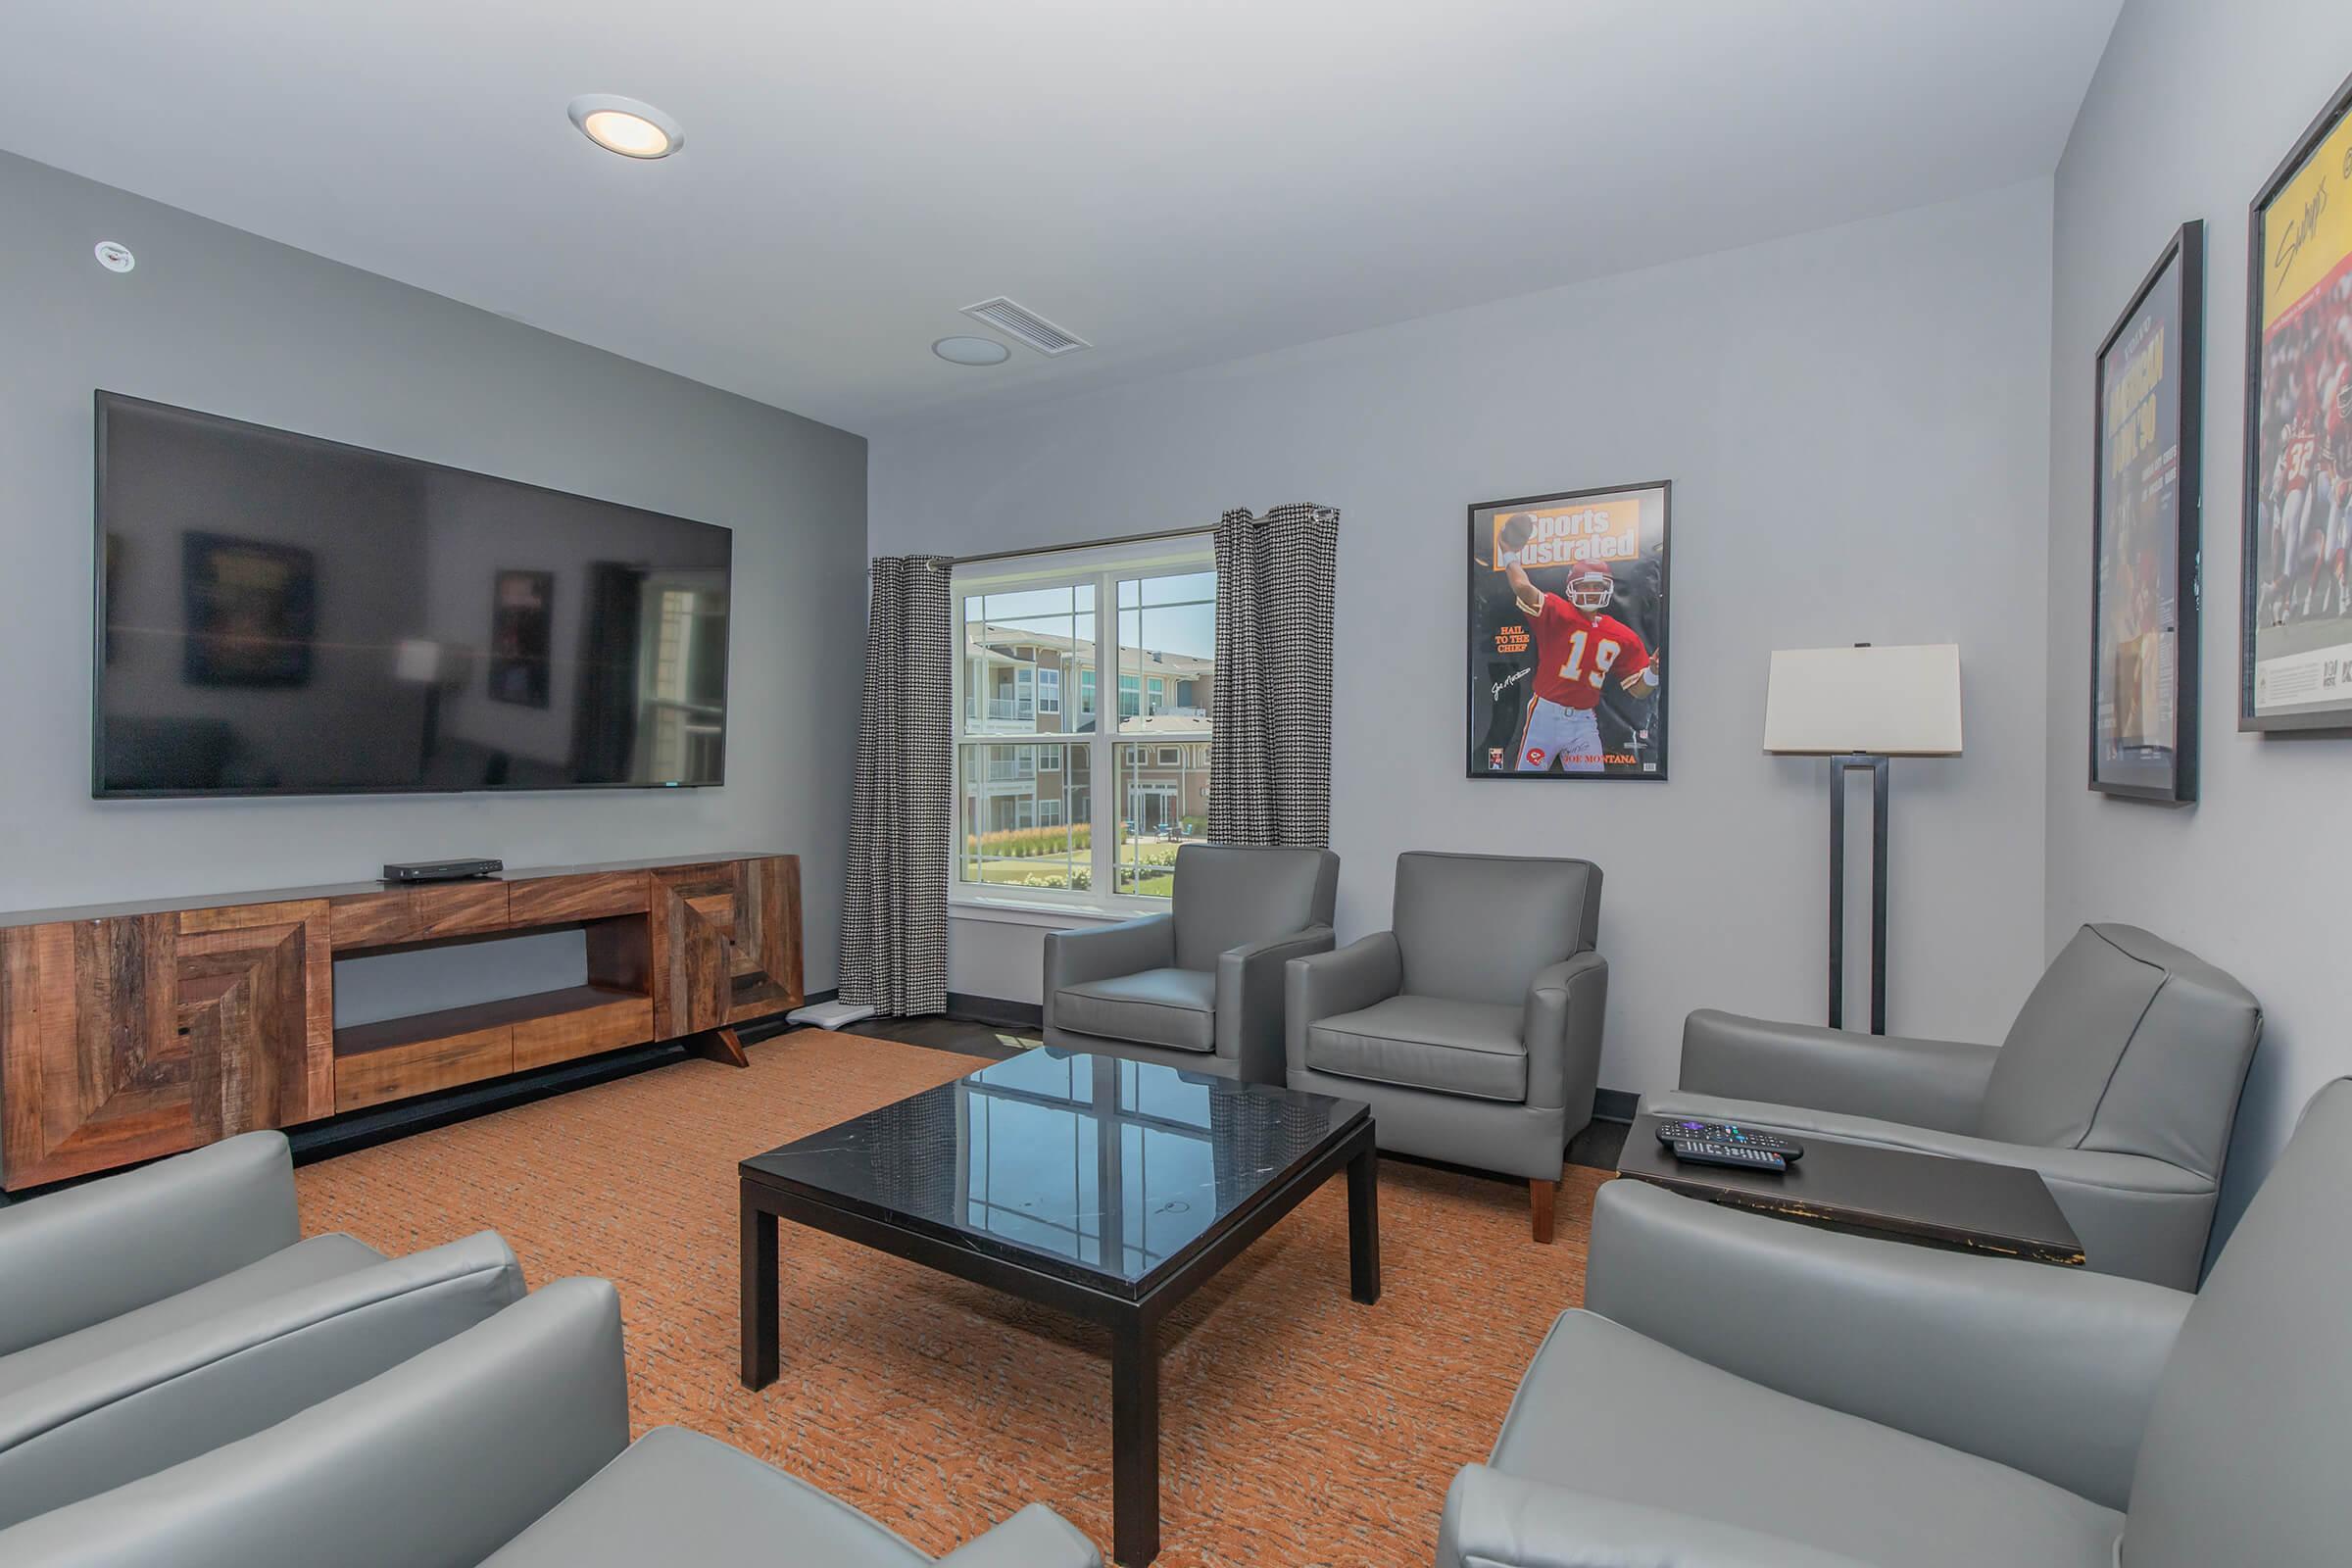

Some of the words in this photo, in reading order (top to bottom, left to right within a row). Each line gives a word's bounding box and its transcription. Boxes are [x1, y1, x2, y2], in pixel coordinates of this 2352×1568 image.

[2287, 441, 2315, 480] 32
[1528, 509, 1610, 543] ports
[1497, 527, 1635, 567] ustrated
[1494, 635, 1508, 644] TO
[1509, 634, 1530, 644] THE
[1500, 625, 1525, 635] HAIL
[1497, 644, 1528, 654] CHIEF
[1558, 630, 1622, 690] 19
[1563, 755, 1582, 764] JOE
[1584, 754, 1637, 764] MONTANA
